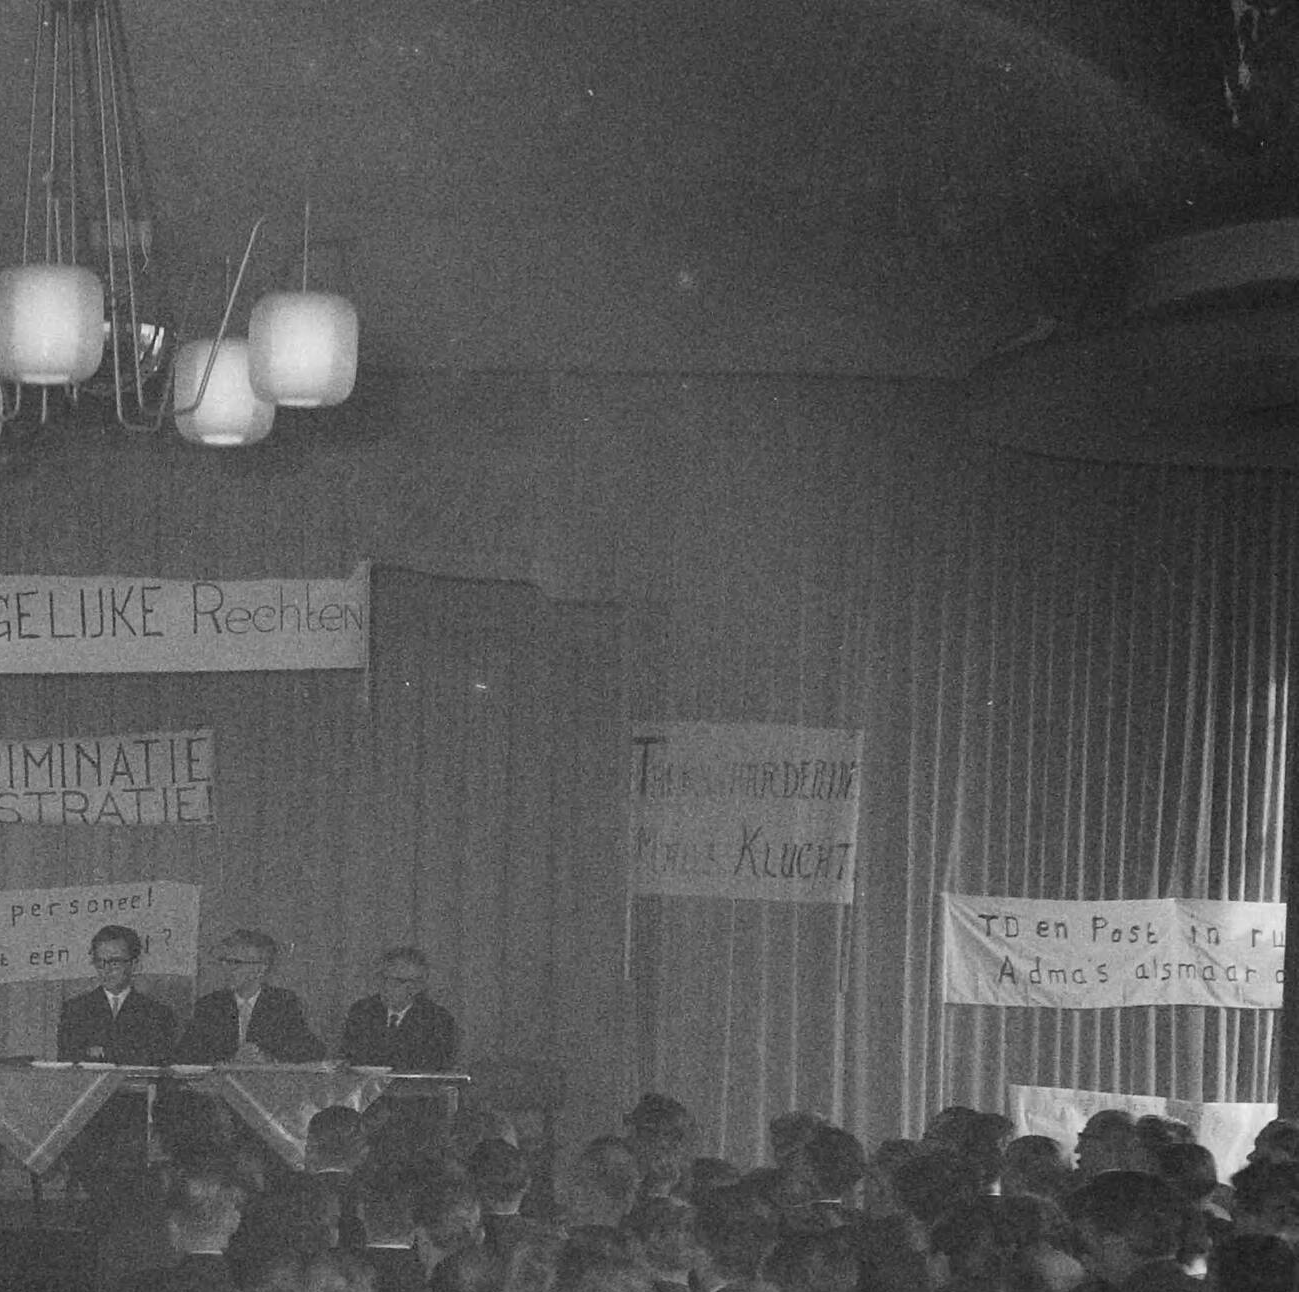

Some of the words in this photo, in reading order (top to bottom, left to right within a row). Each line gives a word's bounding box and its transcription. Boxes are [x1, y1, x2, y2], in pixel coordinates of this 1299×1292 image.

[11, 887, 152, 926] personeel
[977, 914, 1020, 938] TD
[1036, 920, 1069, 939] en
[1092, 915, 1157, 944] Post
[1189, 913, 1220, 945] in
[1135, 957, 1258, 983] alsmaar
